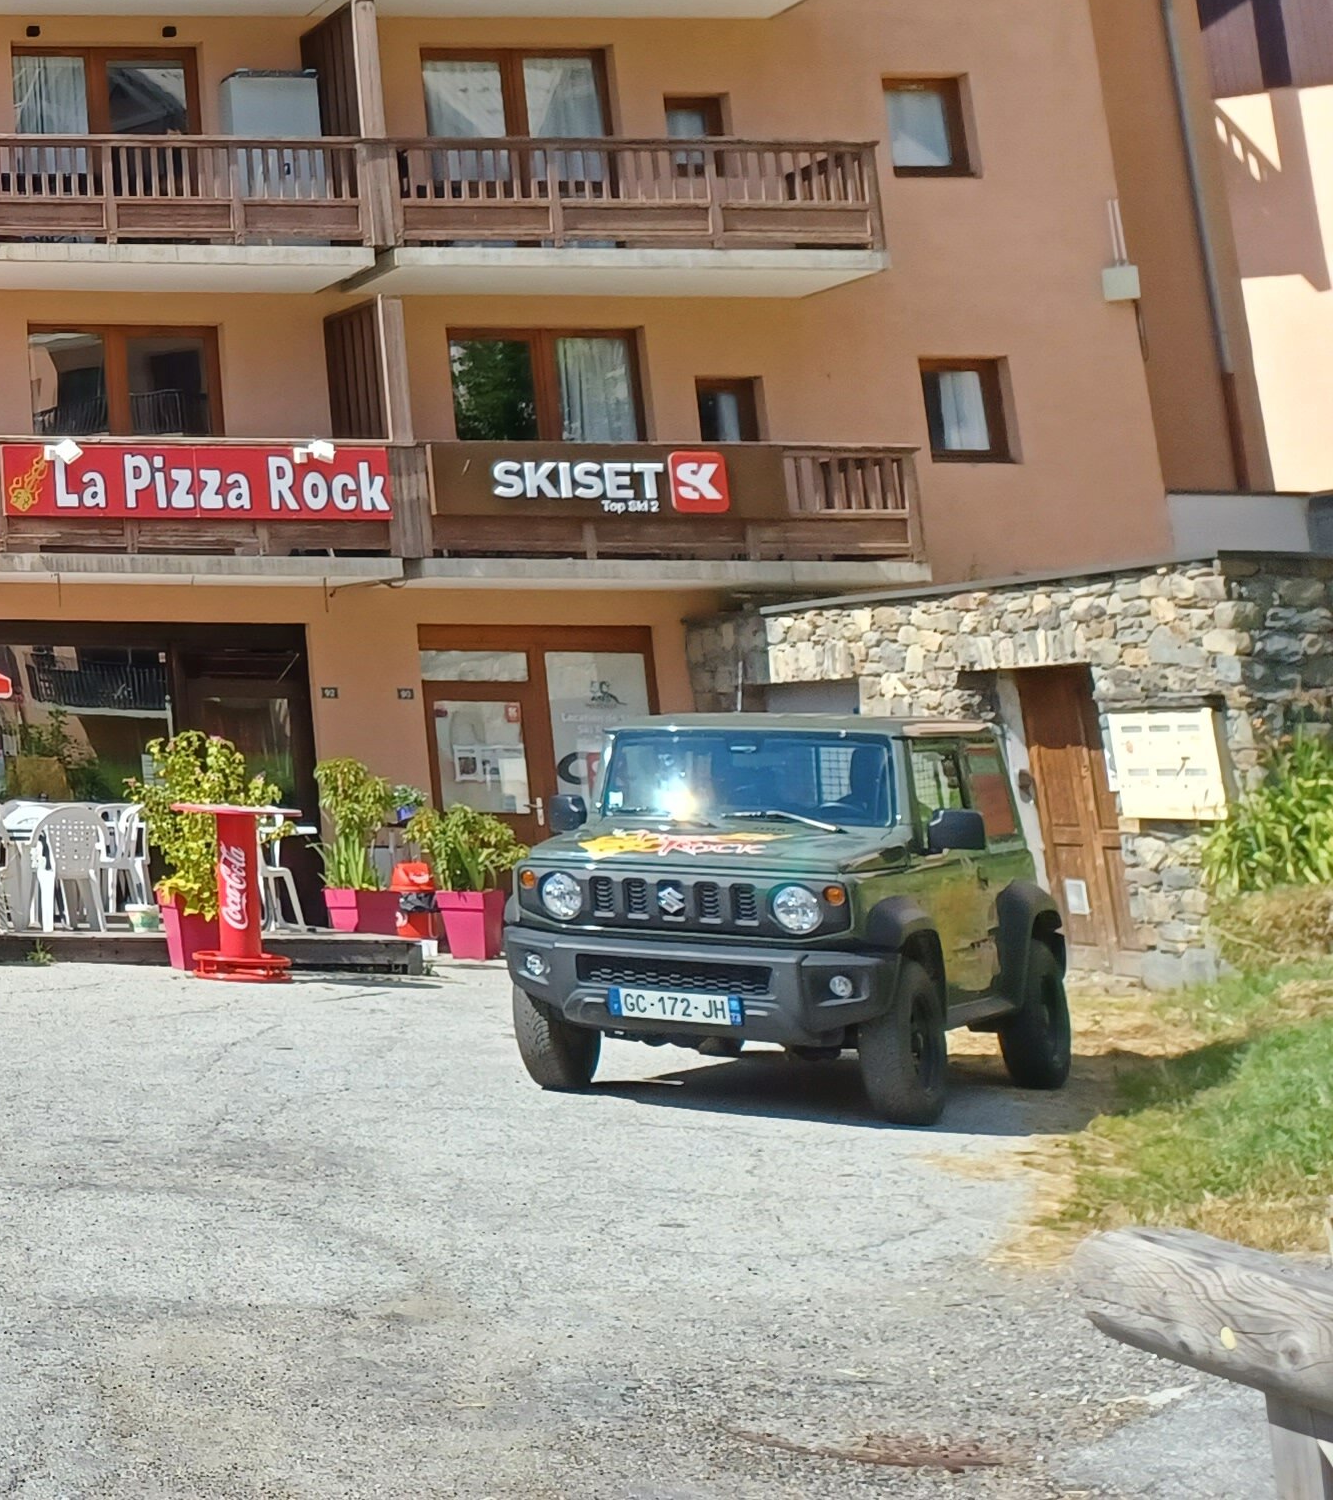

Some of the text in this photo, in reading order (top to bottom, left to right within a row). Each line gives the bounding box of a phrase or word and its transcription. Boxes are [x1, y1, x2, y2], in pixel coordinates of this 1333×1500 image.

[54, 451, 391, 512] La Pizza Rock
[493, 460, 724, 500] SKISET SK
[601, 500, 660, 515] Top Ski 2
